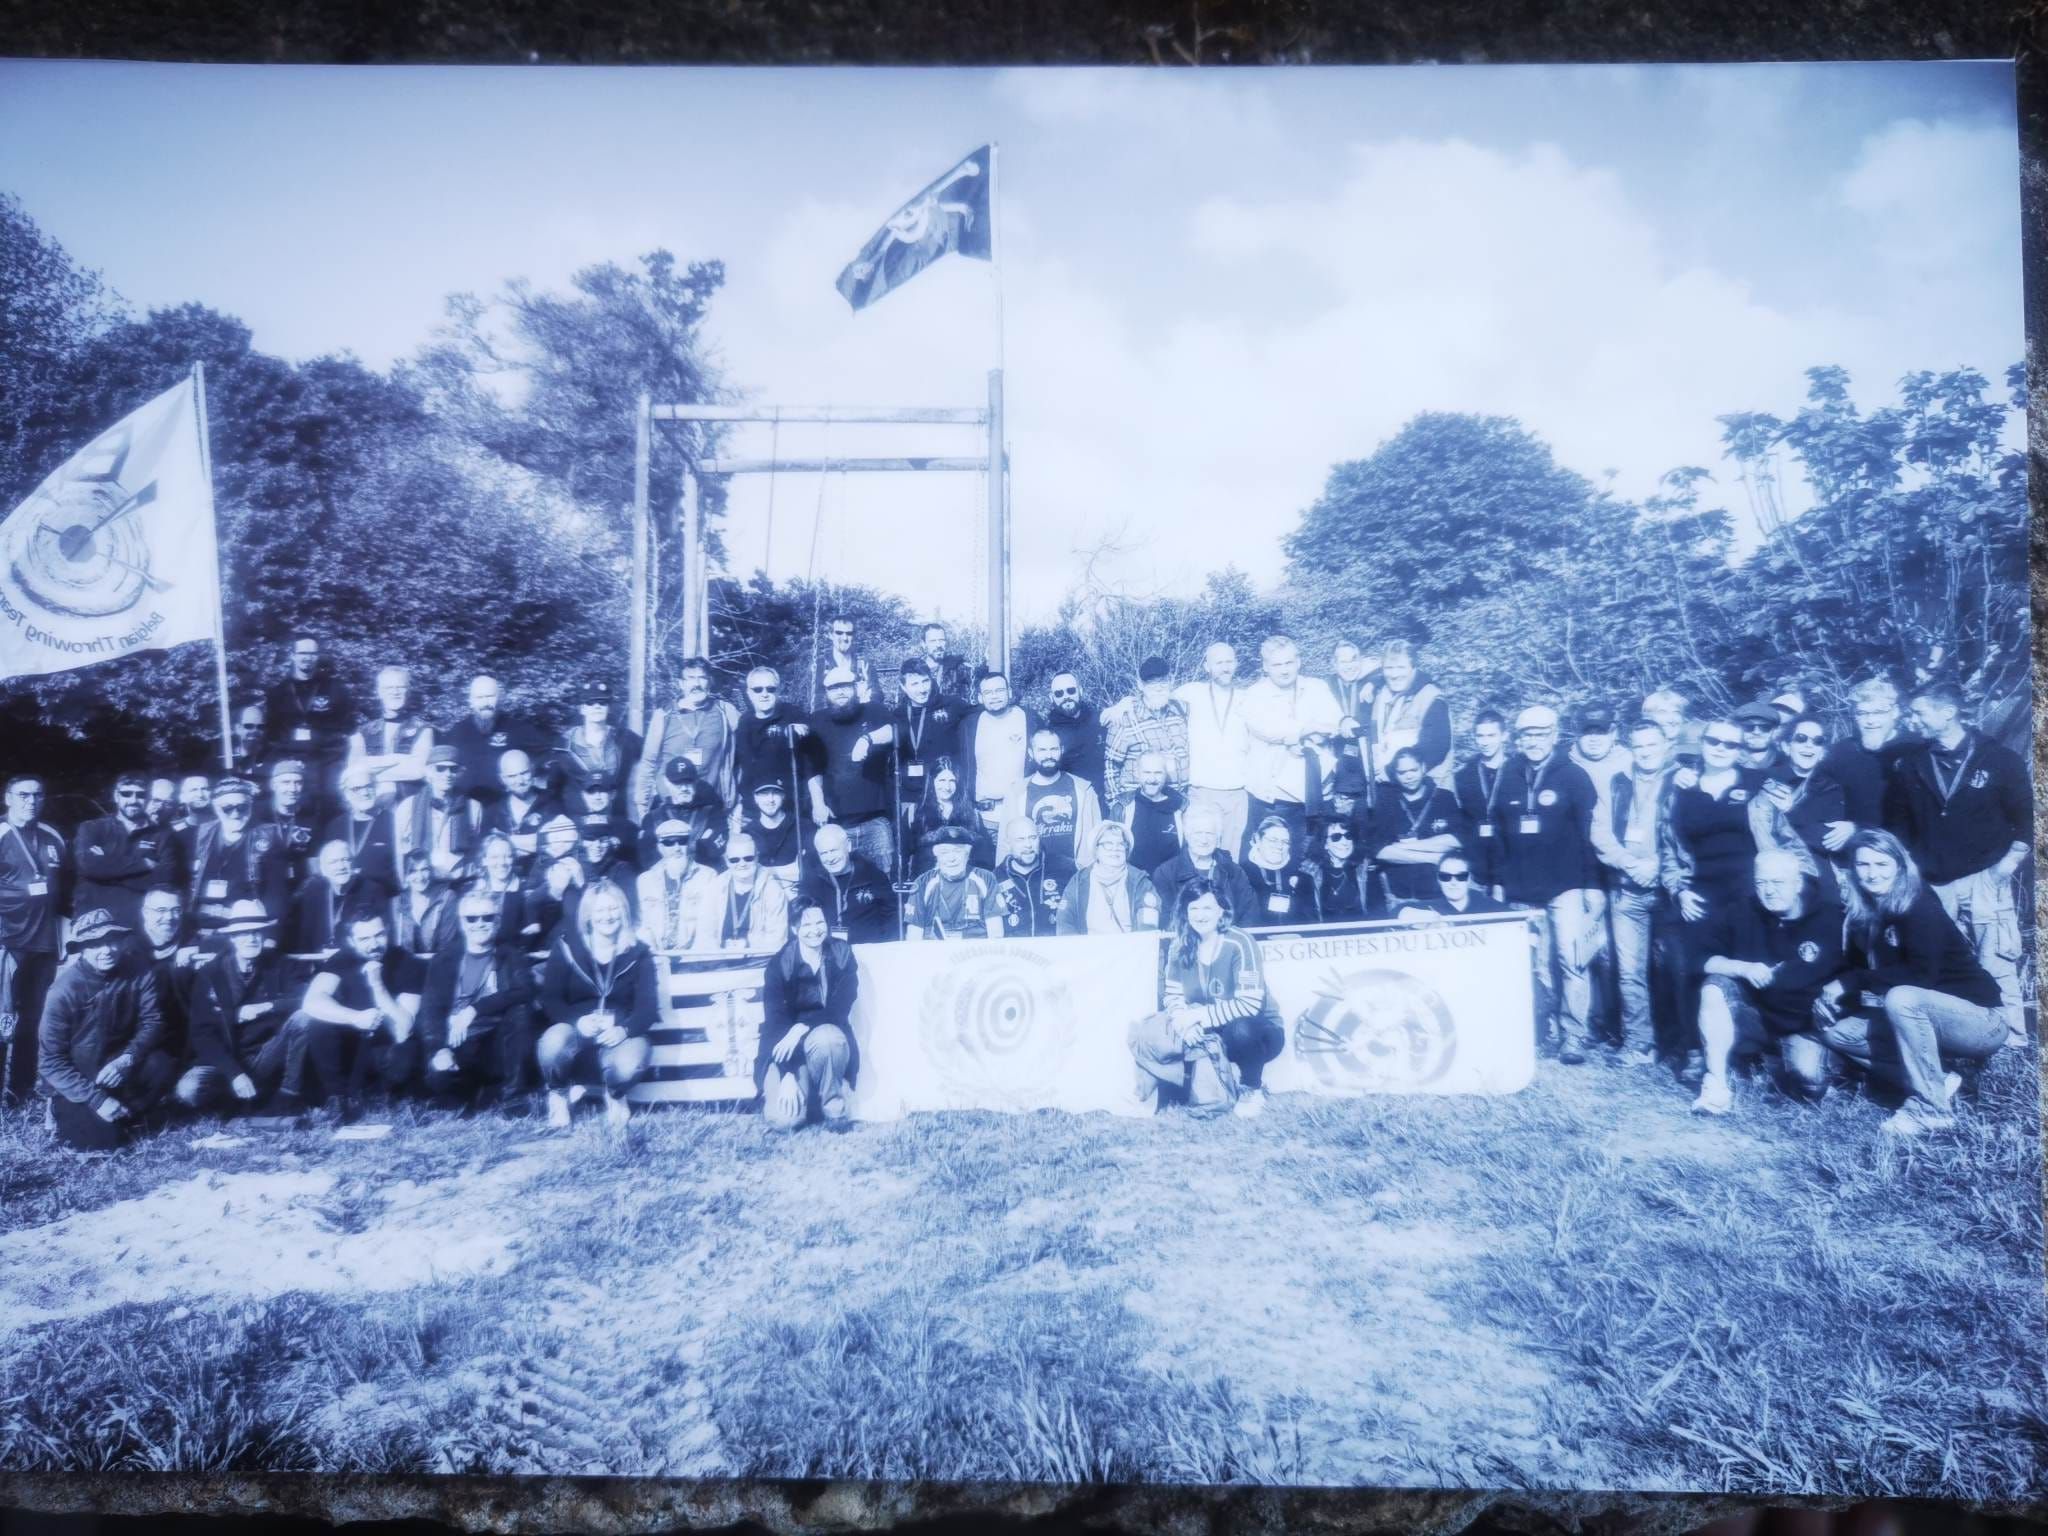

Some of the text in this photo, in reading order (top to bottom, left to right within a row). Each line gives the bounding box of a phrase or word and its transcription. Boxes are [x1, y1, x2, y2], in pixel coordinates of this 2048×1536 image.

[677, 762, 686, 773] P
[1262, 928, 1489, 962] ES GRIFFES DU LYON
